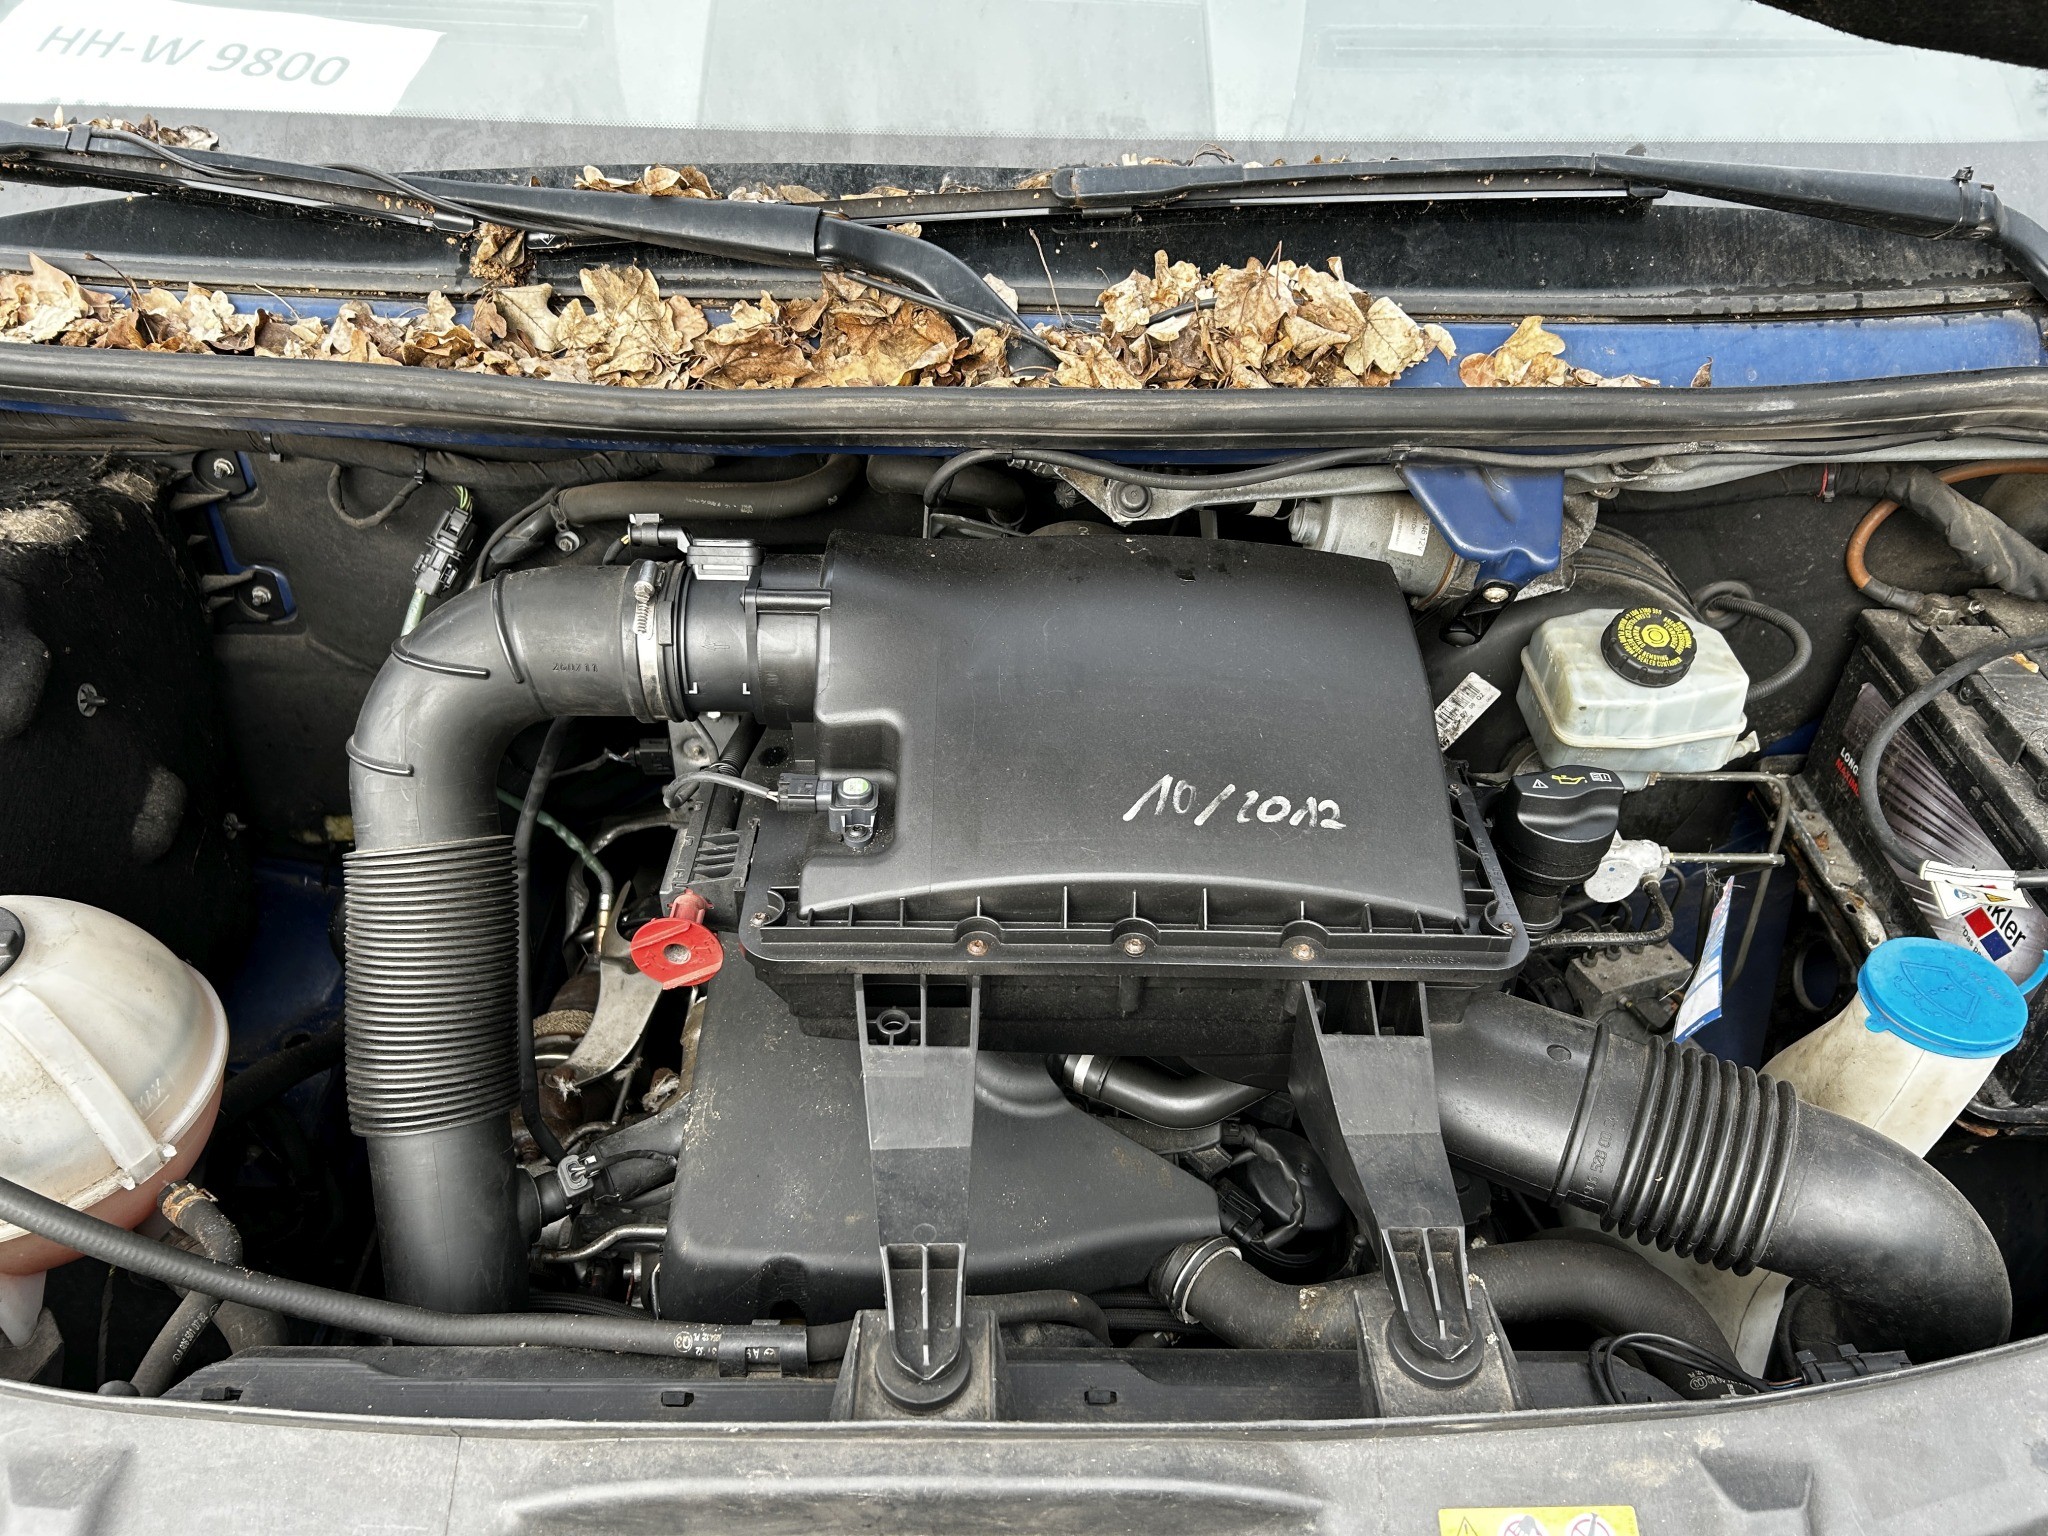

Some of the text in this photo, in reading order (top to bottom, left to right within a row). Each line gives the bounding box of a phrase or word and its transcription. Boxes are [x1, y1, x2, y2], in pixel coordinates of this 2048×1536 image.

[37, 26, 351, 87] HH-W 9800
[1122, 773, 1347, 830] 10/2012
